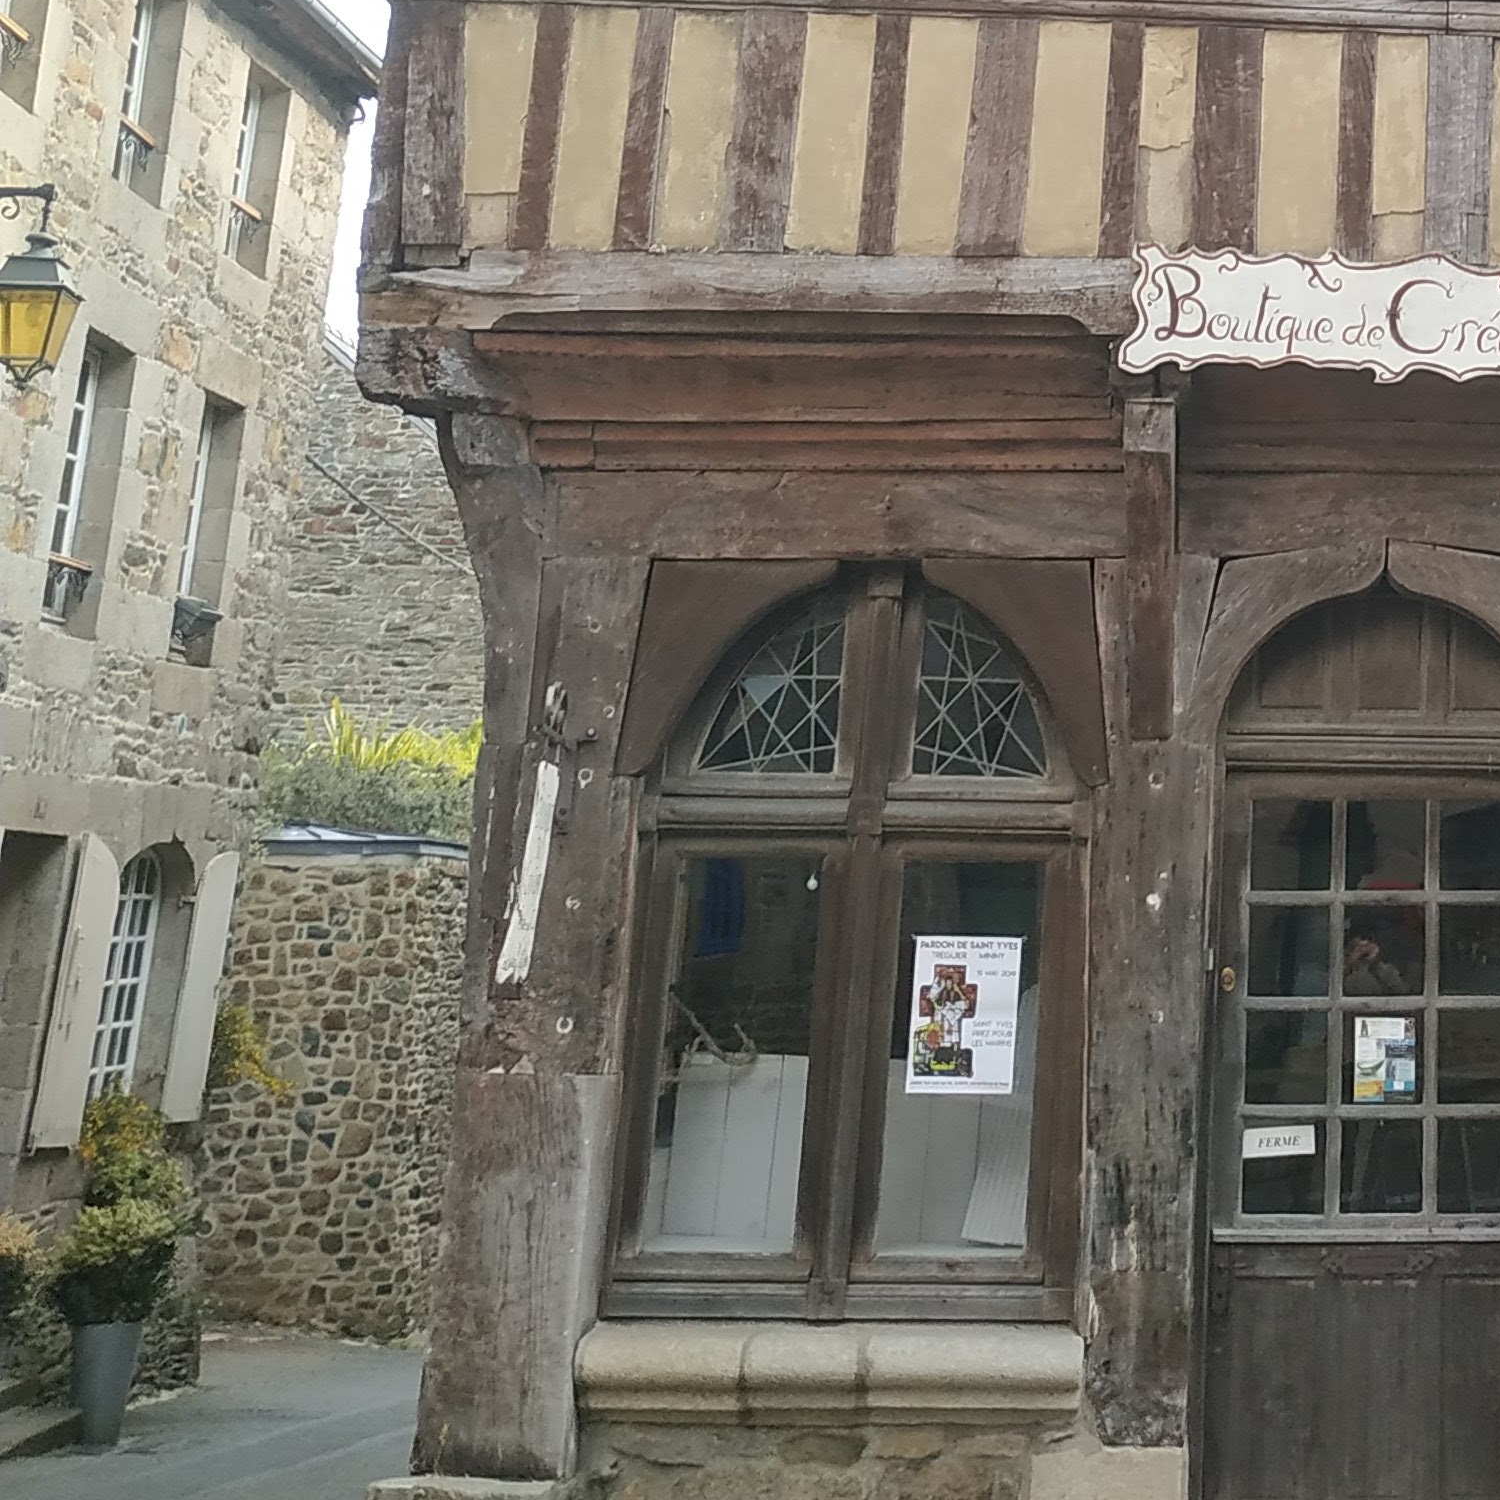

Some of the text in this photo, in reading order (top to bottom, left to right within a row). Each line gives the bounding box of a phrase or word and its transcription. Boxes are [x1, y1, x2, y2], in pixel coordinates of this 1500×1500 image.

[1147, 264, 1333, 353] Boutique
[1341, 304, 1385, 347] de
[920, 940, 1018, 950] PARDON DE SAINT YVES
[996, 1020, 1013, 1028] YVES
